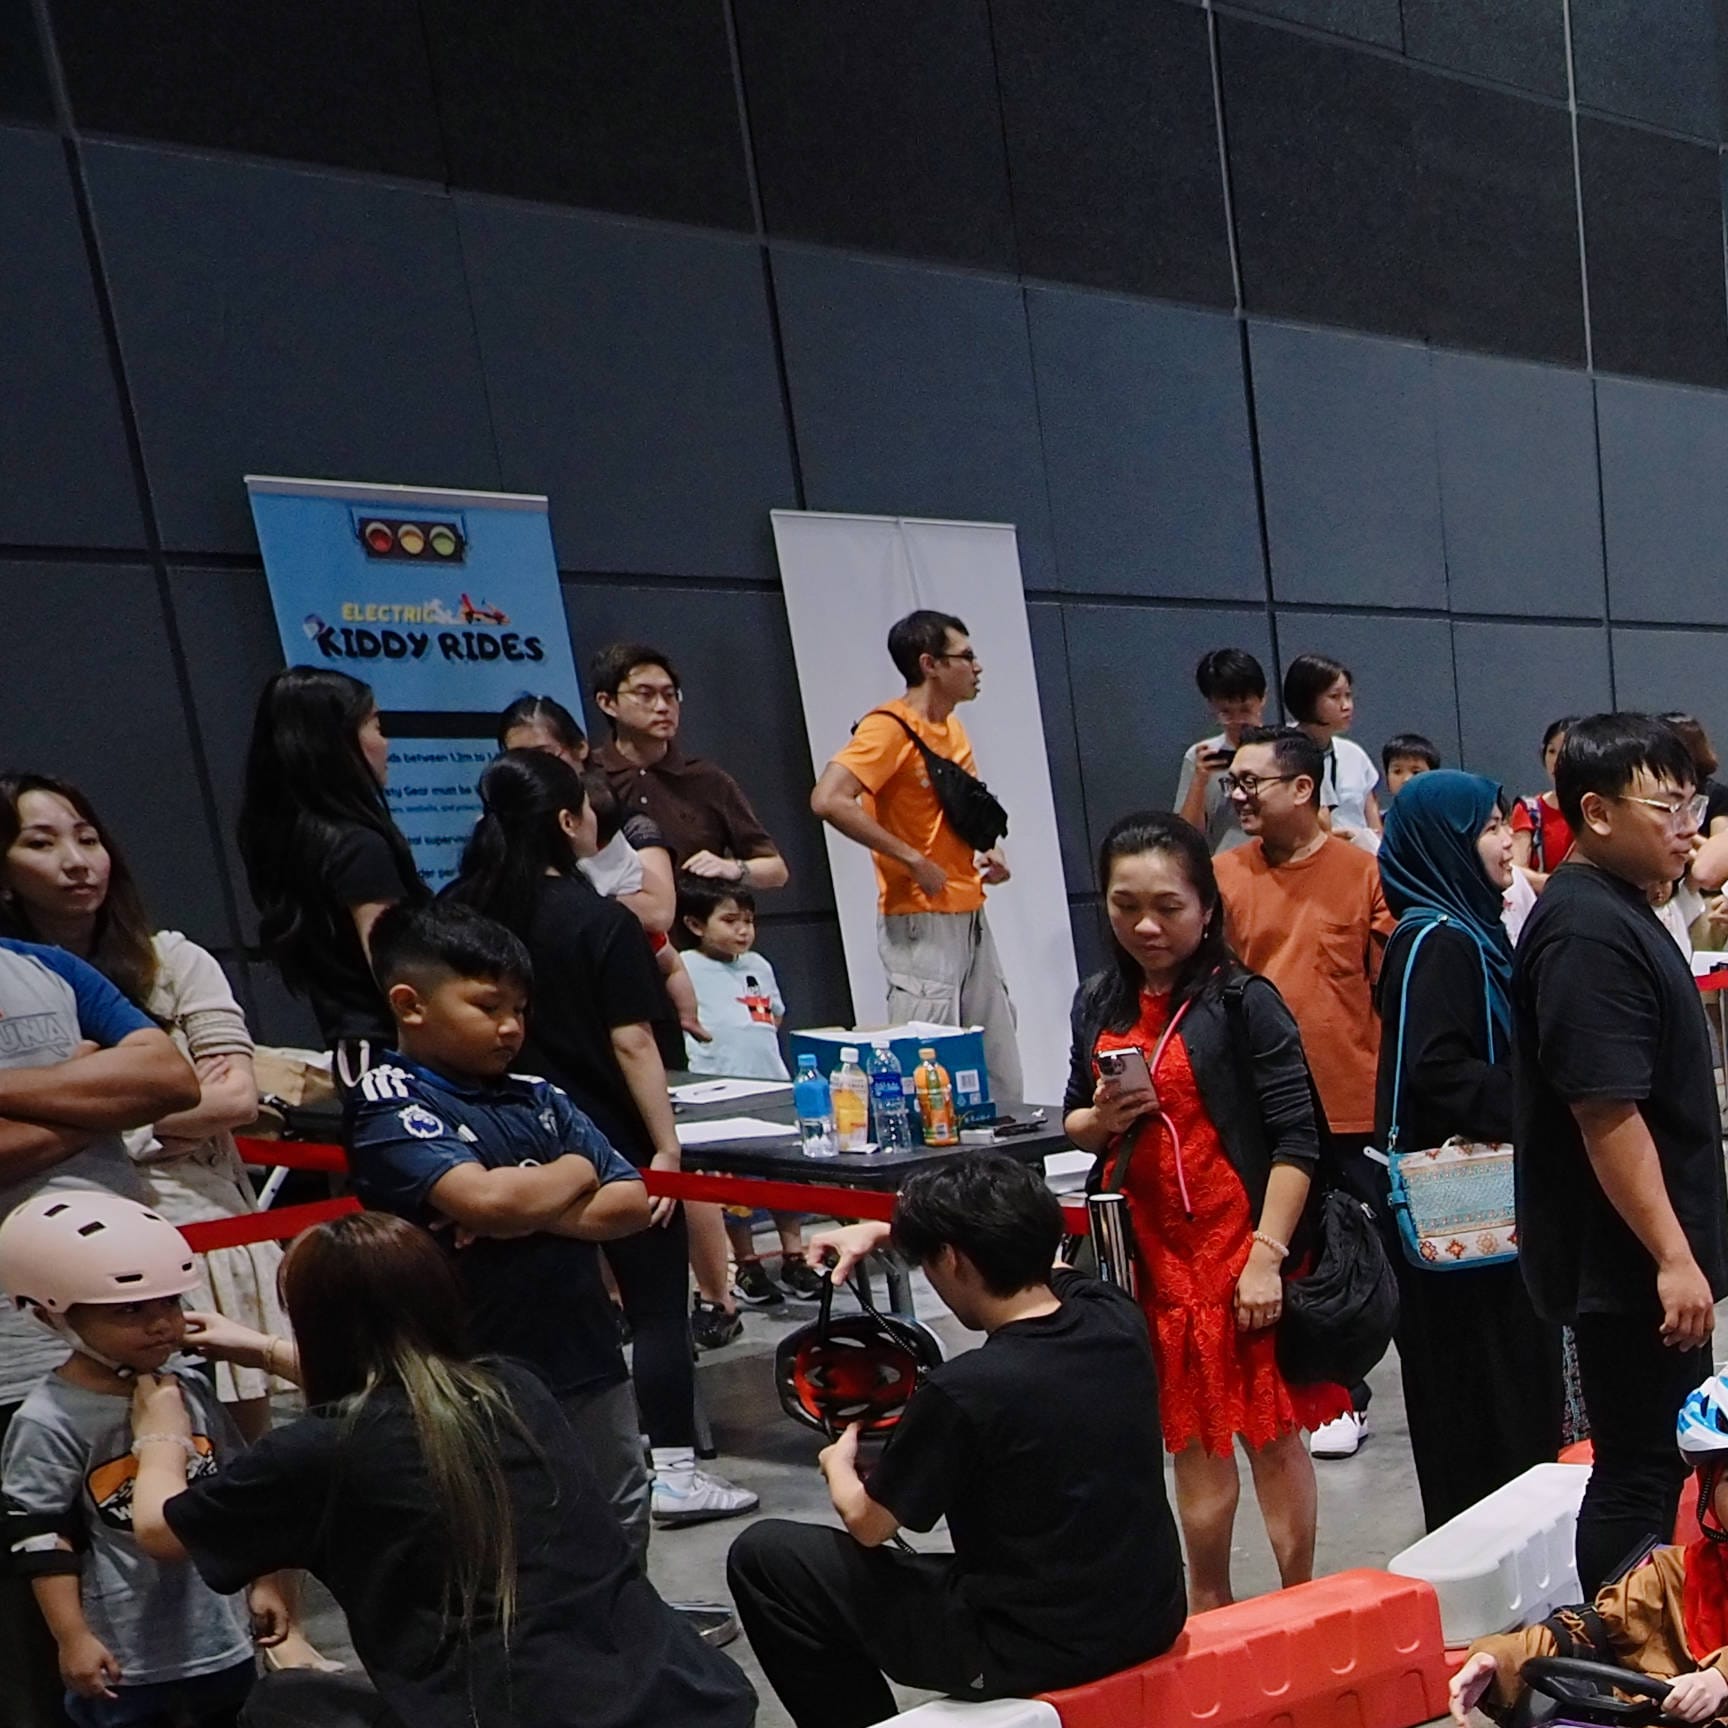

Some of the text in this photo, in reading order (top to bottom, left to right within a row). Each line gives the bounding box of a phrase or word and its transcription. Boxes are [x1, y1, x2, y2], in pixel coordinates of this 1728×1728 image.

[341, 602, 437, 625] ELECTRIC
[317, 625, 546, 663] KIDDY RIDES
